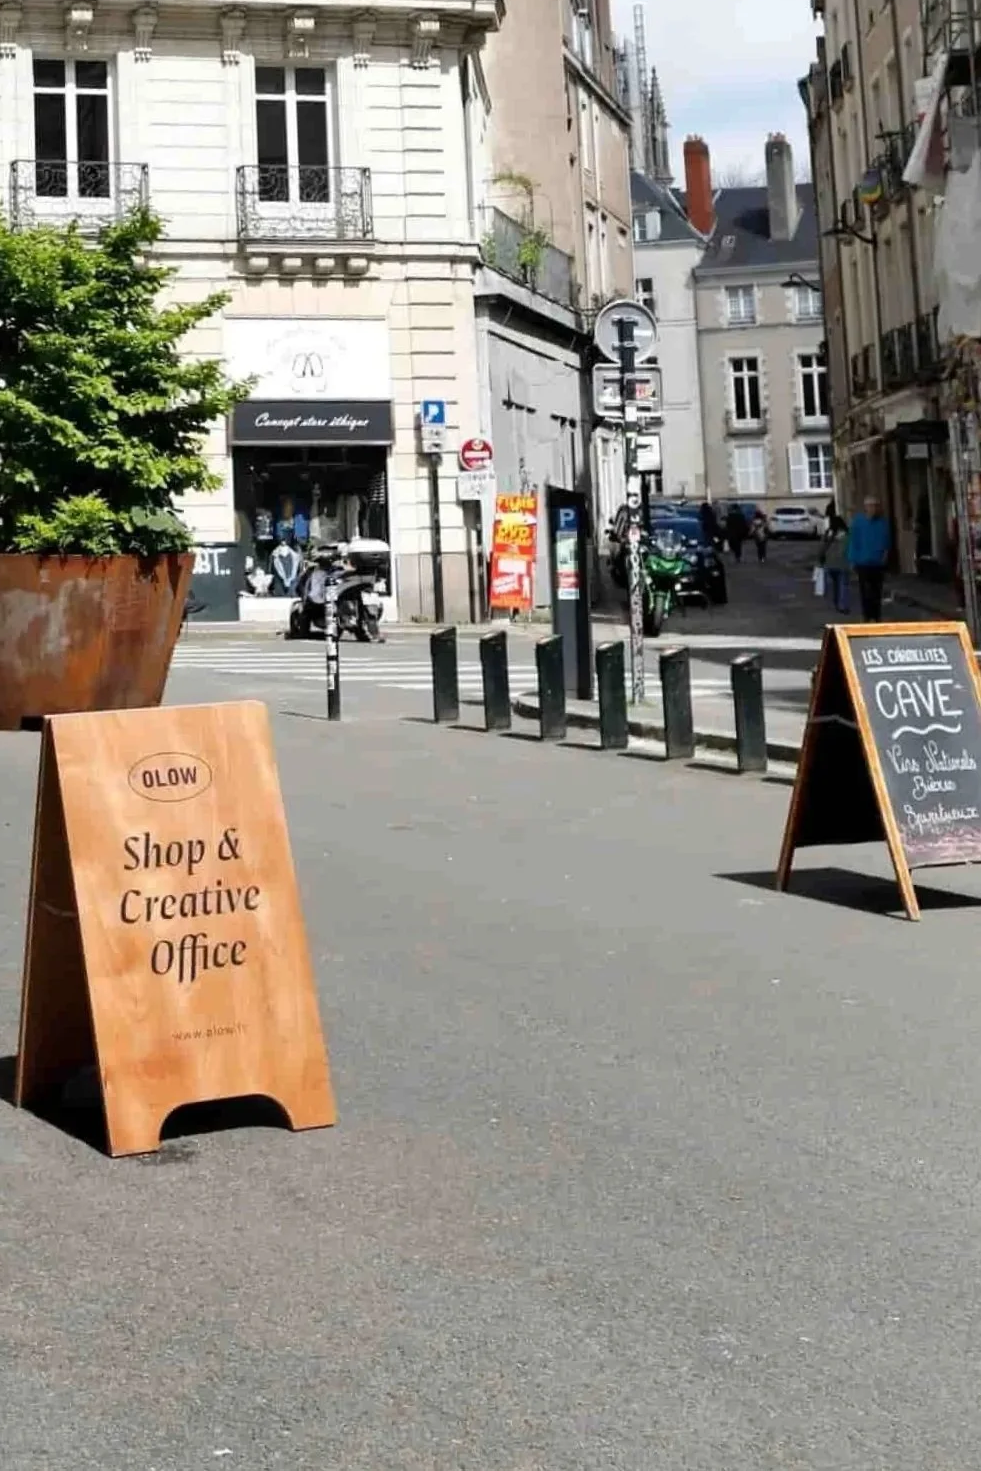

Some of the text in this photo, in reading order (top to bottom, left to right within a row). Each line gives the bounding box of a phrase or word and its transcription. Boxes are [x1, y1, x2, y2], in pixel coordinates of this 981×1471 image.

[255, 412, 301, 431] Concept
[560, 508, 575, 528] P
[861, 648, 883, 665] LES
[875, 679, 964, 719] CAVE
[142, 766, 197, 789] OLOW
[123, 827, 241, 876] Shop &
[120, 879, 261, 925] Creative
[150, 932, 247, 984] Office
